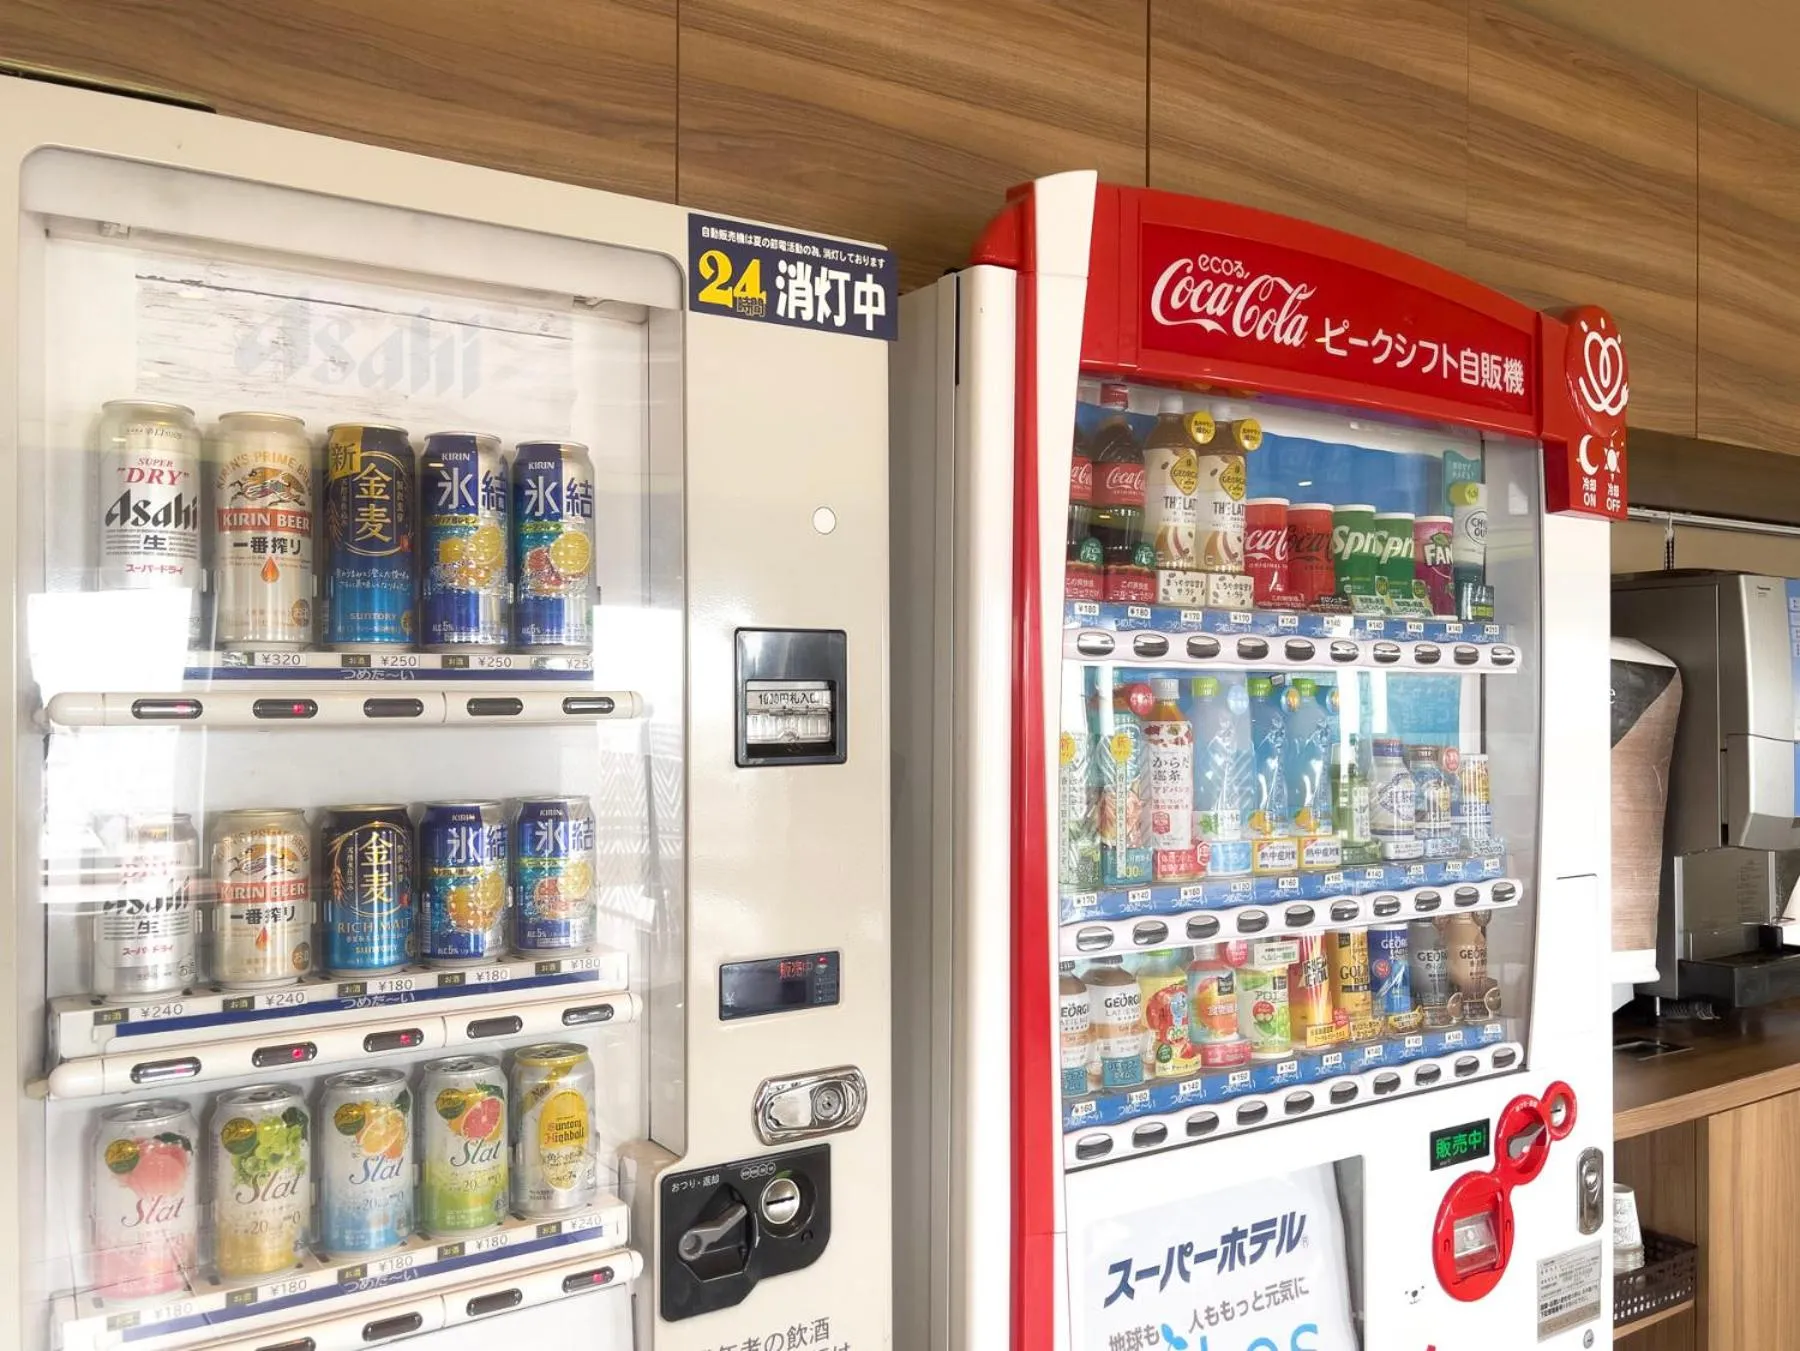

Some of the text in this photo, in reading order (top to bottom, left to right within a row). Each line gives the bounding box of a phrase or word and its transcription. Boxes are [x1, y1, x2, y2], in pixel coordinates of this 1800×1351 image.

[698, 249, 767, 308] 24
[775, 259, 886, 331] 消灯中
[1150, 258, 1317, 348] Coca-Cola
[1320, 317, 1525, 396] ピークシフト自販機
[330, 442, 356, 473] 新
[441, 452, 470, 461] KIRIN
[528, 461, 555, 470] KIRIN
[437, 467, 507, 513] 氷結
[524, 477, 594, 518] 氷結
[1583, 492, 1597, 507] ON
[105, 489, 198, 530] Asahi
[351, 462, 393, 543] 金麦
[1606, 497, 1620, 512] OFF
[221, 510, 310, 531] KIRIN BEER
[142, 534, 167, 551] 生
[232, 536, 302, 556] 一番搾り
[262, 653, 301, 666] ¥320
[381, 656, 417, 667] ¥250
[478, 657, 512, 668] ¥250
[447, 824, 508, 863] 氷結
[535, 817, 596, 853] 氷結
[359, 831, 394, 905] 金麦
[271, 882, 305, 896] BEER
[230, 906, 295, 925] 一番搾り
[571, 957, 601, 969] ¥180
[378, 979, 413, 991] ¥180
[476, 969, 509, 981] ¥180
[265, 991, 305, 1007] ¥240
[141, 1003, 184, 1018] ¥240
[450, 1139, 501, 1167] Slat
[1436, 1130, 1482, 1161] 販売中
[349, 1157, 404, 1185] Slat
[235, 1171, 302, 1205] Slat
[121, 1194, 184, 1228] Slat
[570, 1215, 602, 1229] ¥240
[475, 1235, 508, 1248] ¥180
[379, 1256, 414, 1272] ¥180
[1103, 1211, 1307, 1309] スーパーホテル
[270, 1279, 307, 1295] ¥180
[1188, 1277, 1310, 1333] 人ももっと元気に
